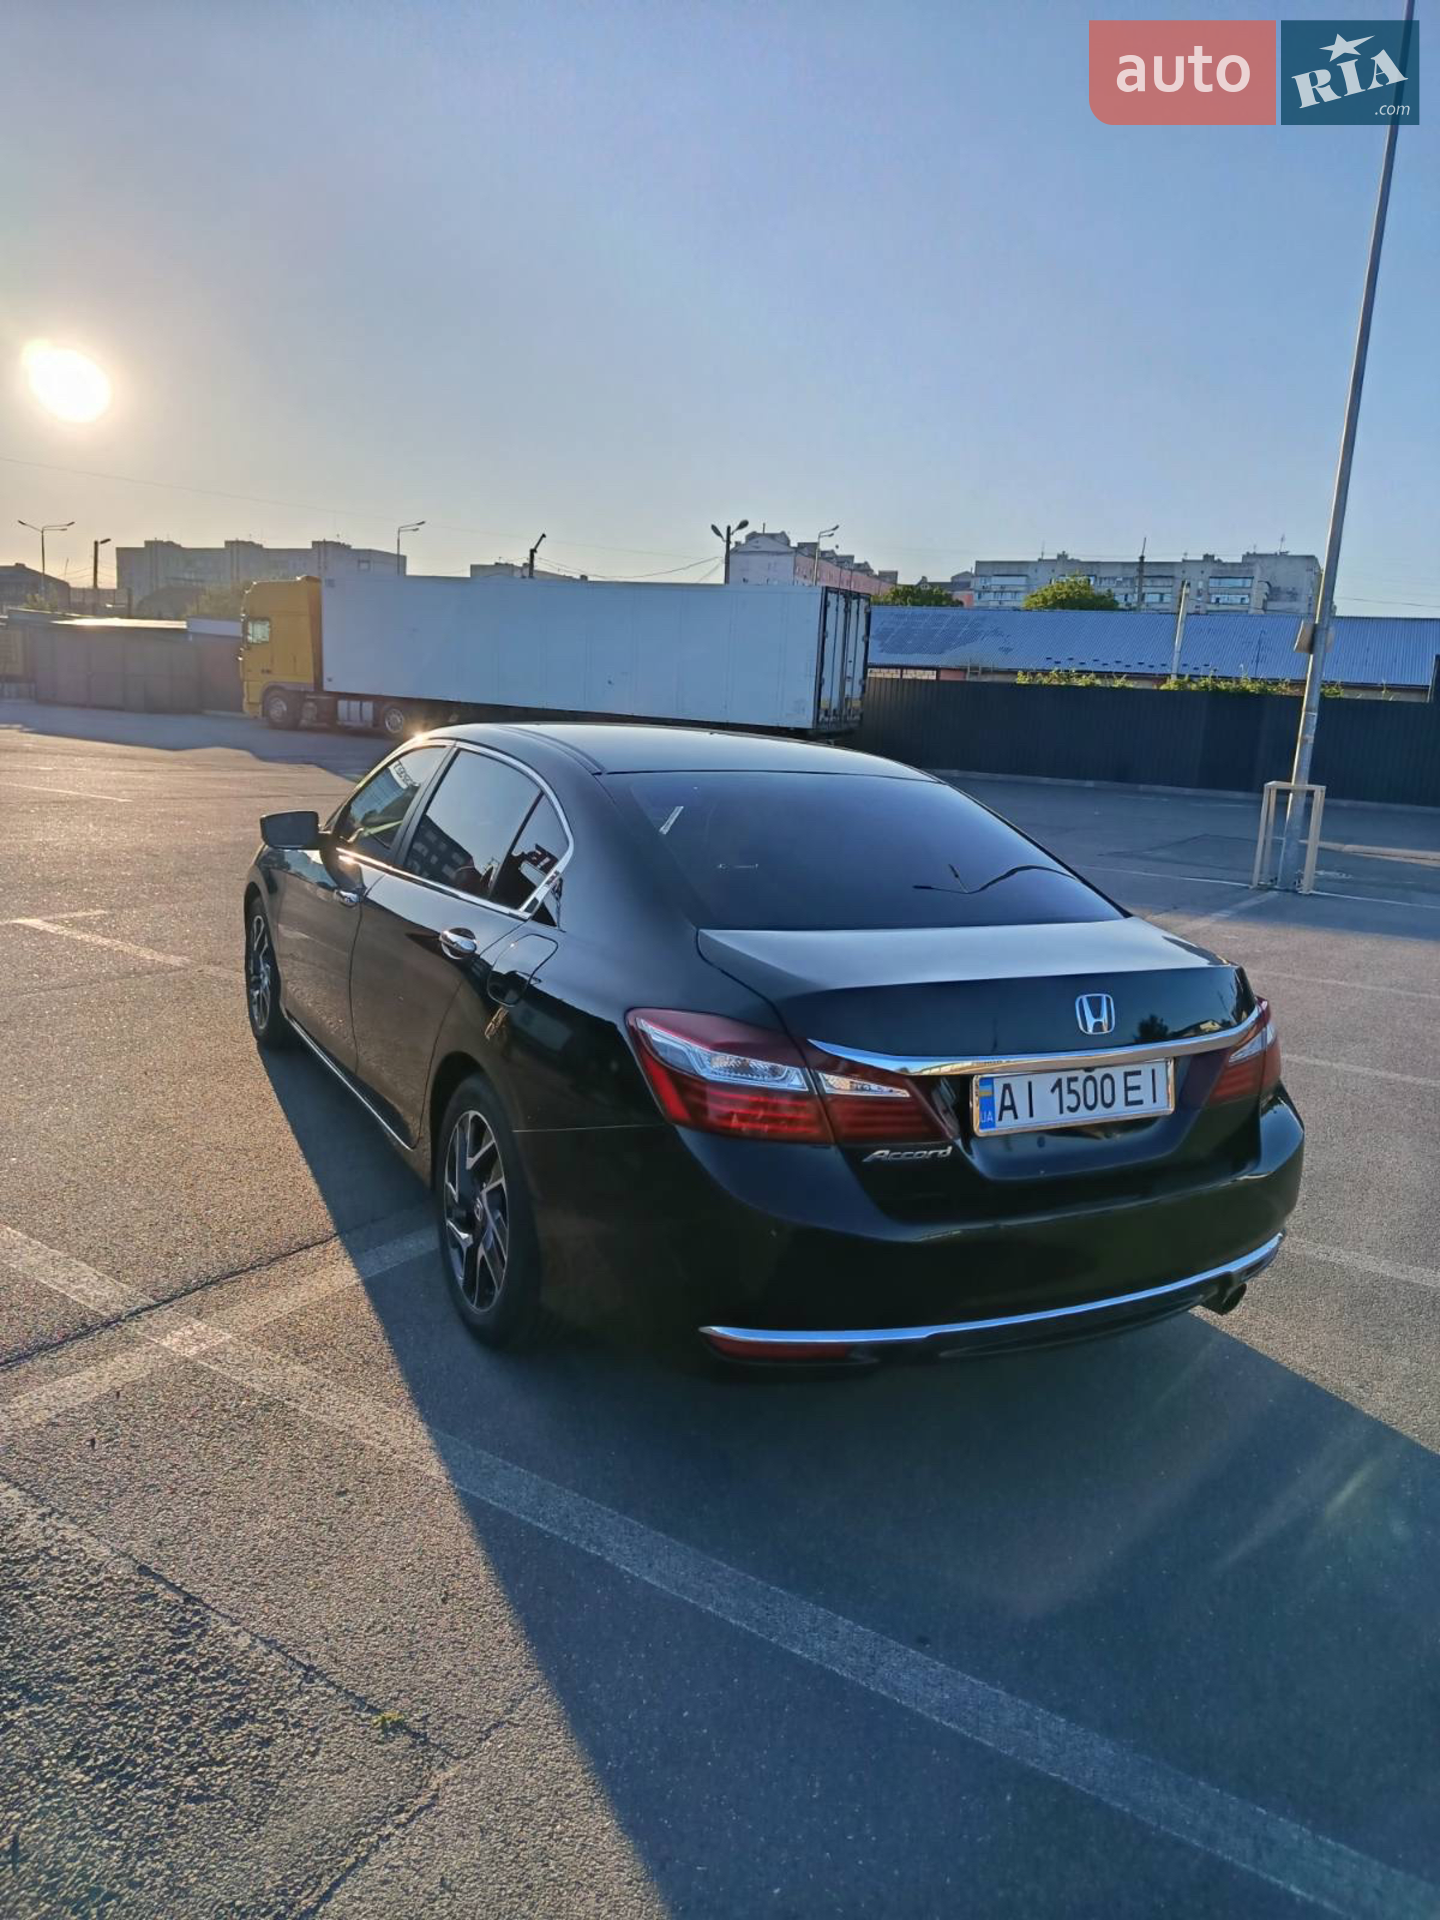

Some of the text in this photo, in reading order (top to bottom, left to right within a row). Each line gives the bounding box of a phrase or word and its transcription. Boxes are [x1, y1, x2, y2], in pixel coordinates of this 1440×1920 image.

[998, 1080, 1034, 1122] AI
[1050, 1073, 1115, 1115] 1500
[1123, 1068, 1157, 1107] EI
[862, 1145, 953, 1163] Accord
